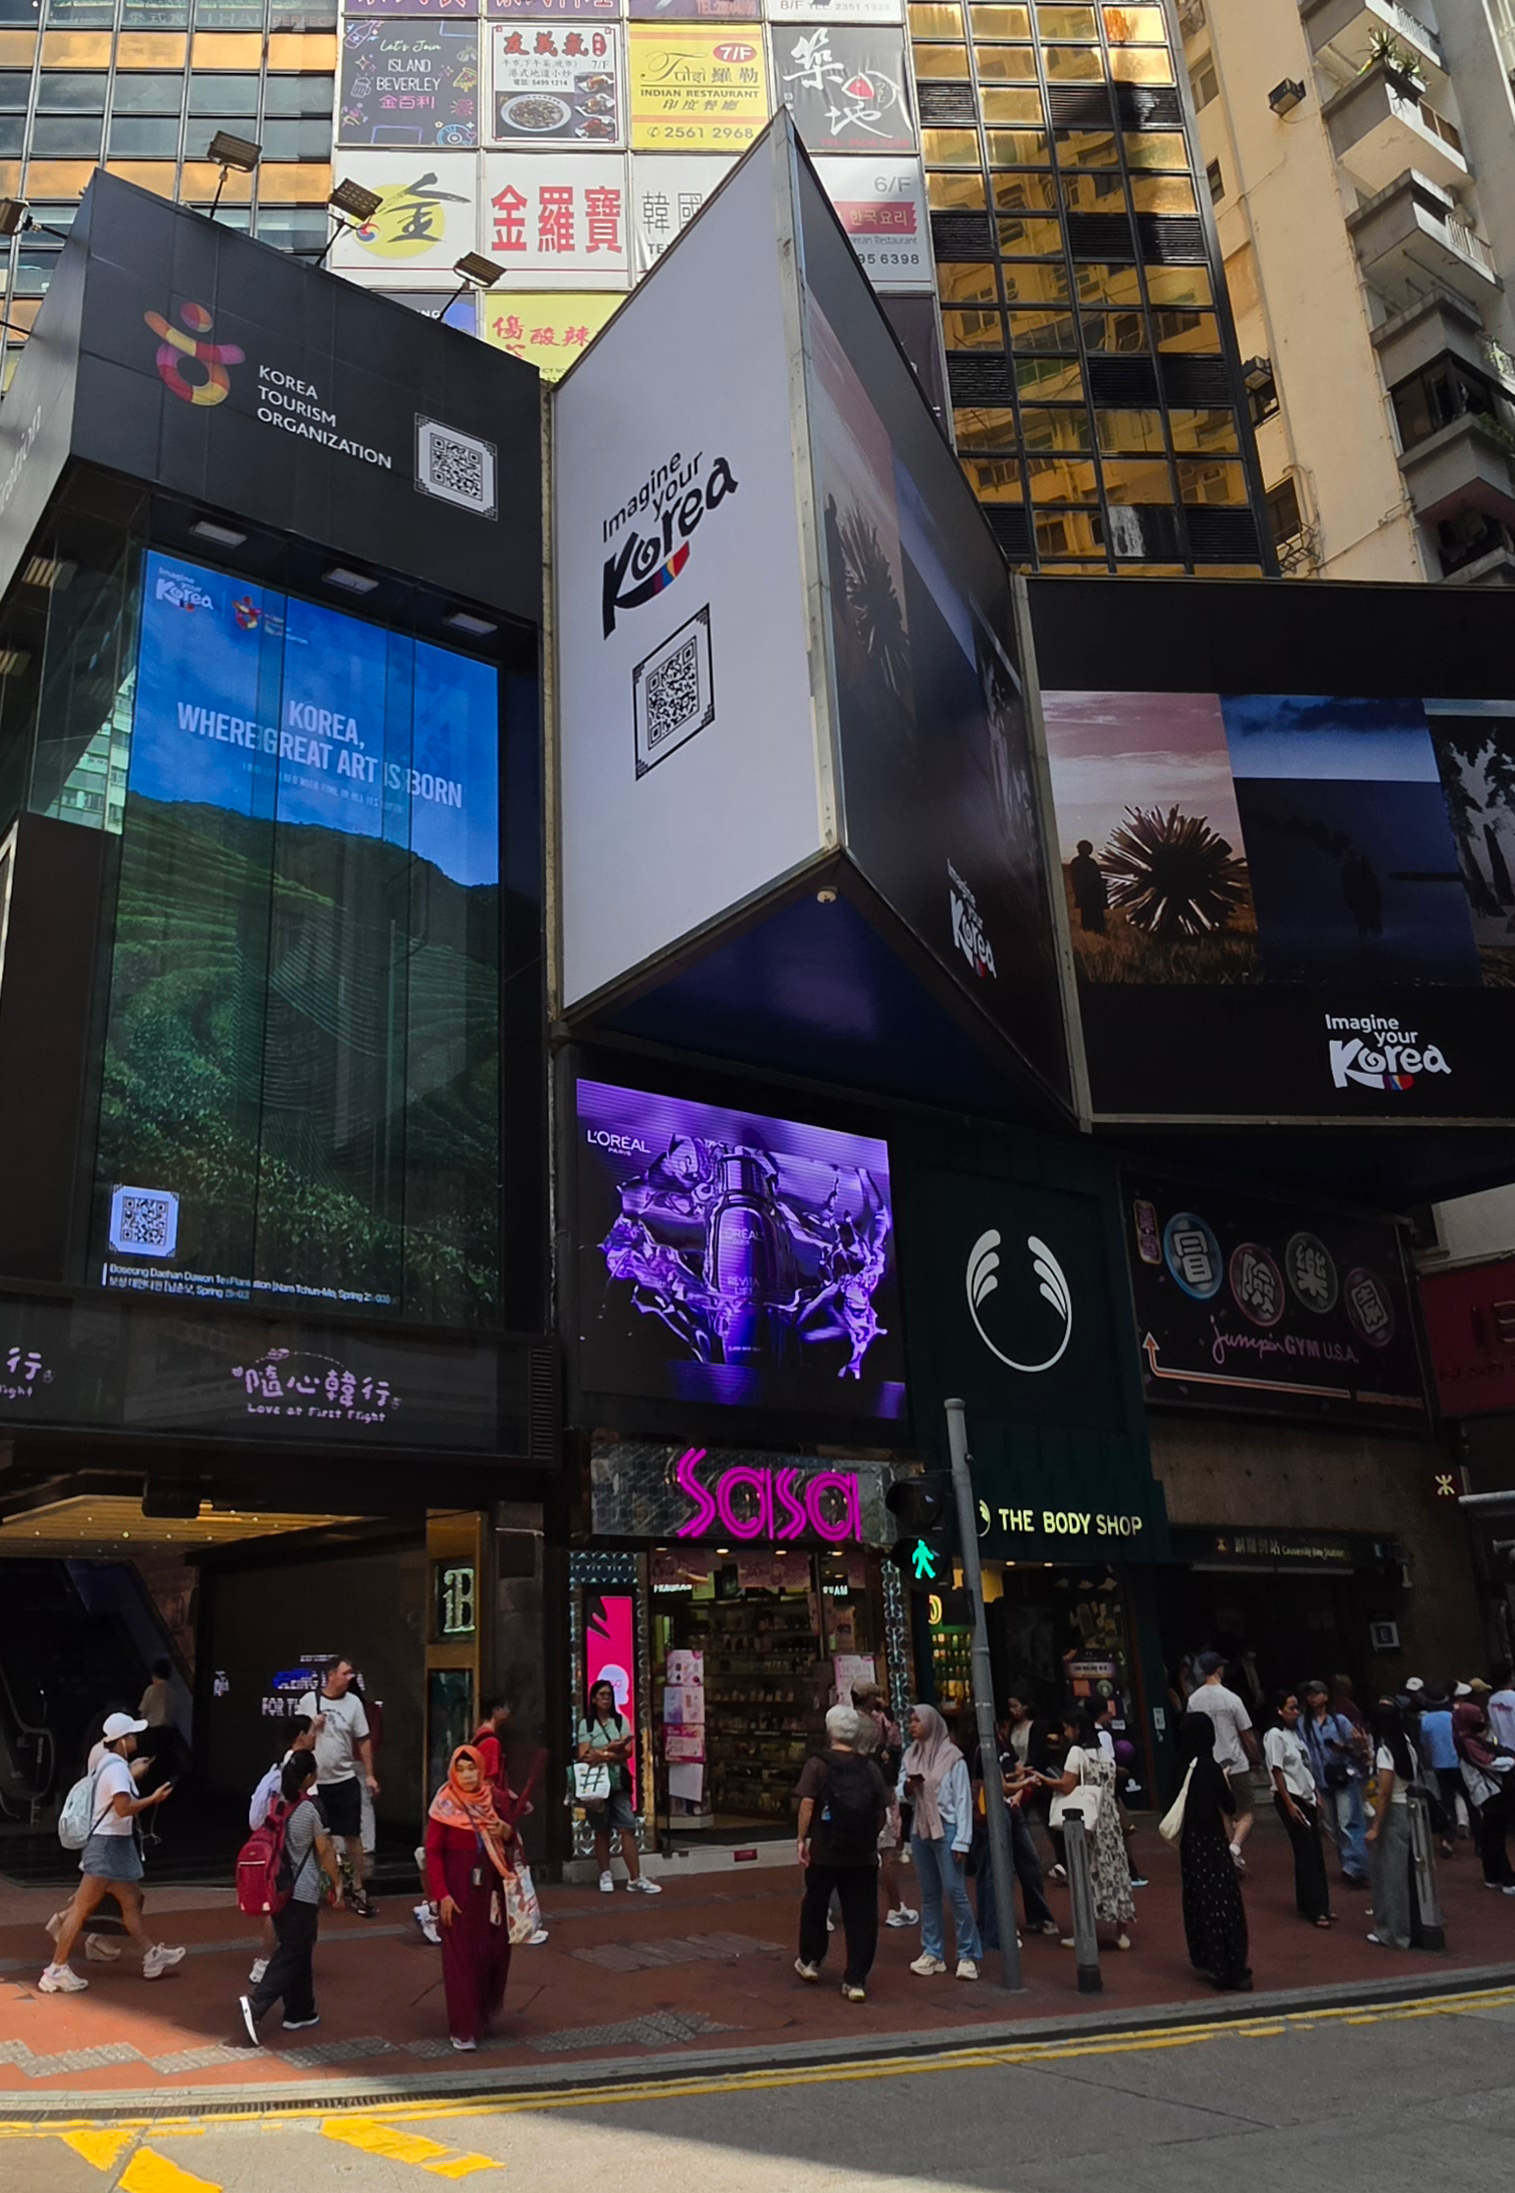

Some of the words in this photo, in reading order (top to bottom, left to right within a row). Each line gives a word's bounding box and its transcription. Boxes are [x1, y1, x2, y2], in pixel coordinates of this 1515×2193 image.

[720, 46, 753, 61] 7/F
[388, 59, 431, 73] ISLAND
[591, 60, 609, 70] 7/F
[376, 76, 441, 91] BEVERLEY
[640, 89, 681, 98] INDIAN
[685, 90, 759, 99] RESTAURANT
[380, 95, 435, 109] 金百利
[662, 99, 739, 111] 印度餐廳
[664, 127, 704, 139] 2561
[712, 128, 755, 139] 2968
[873, 176, 912, 193] 6/F
[490, 184, 623, 254] 金羅寶
[849, 209, 908, 227] 한국요리
[873, 235, 918, 246] Restaurant
[857, 253, 877, 265] 95
[880, 253, 920, 265] 6398
[529, 325, 592, 348] 酸辣
[259, 365, 318, 399] KOREA
[258, 385, 336, 427] TOURISM
[257, 408, 392, 469] ORGANIZATION
[652, 451, 703, 522] your
[602, 452, 682, 543] Imagine
[602, 457, 739, 641] Korea
[156, 578, 214, 612] Korea
[289, 699, 365, 750] KOREA,
[177, 701, 256, 750] WHERE
[262, 727, 334, 770] GREAT
[336, 749, 379, 783] ART
[384, 761, 402, 790] IS
[408, 767, 463, 808] BORN
[949, 889, 997, 978] Korea
[1325, 1013, 1399, 1033] Imagine
[1374, 1031, 1418, 1047] your
[1329, 1038, 1452, 1090] Korea
[1284, 1335, 1321, 1358] GYM
[247, 1403, 281, 1415] Love
[998, 1508, 1035, 1532] THE
[1042, 1511, 1091, 1535] BODY
[1096, 1514, 1143, 1536] SHOP
